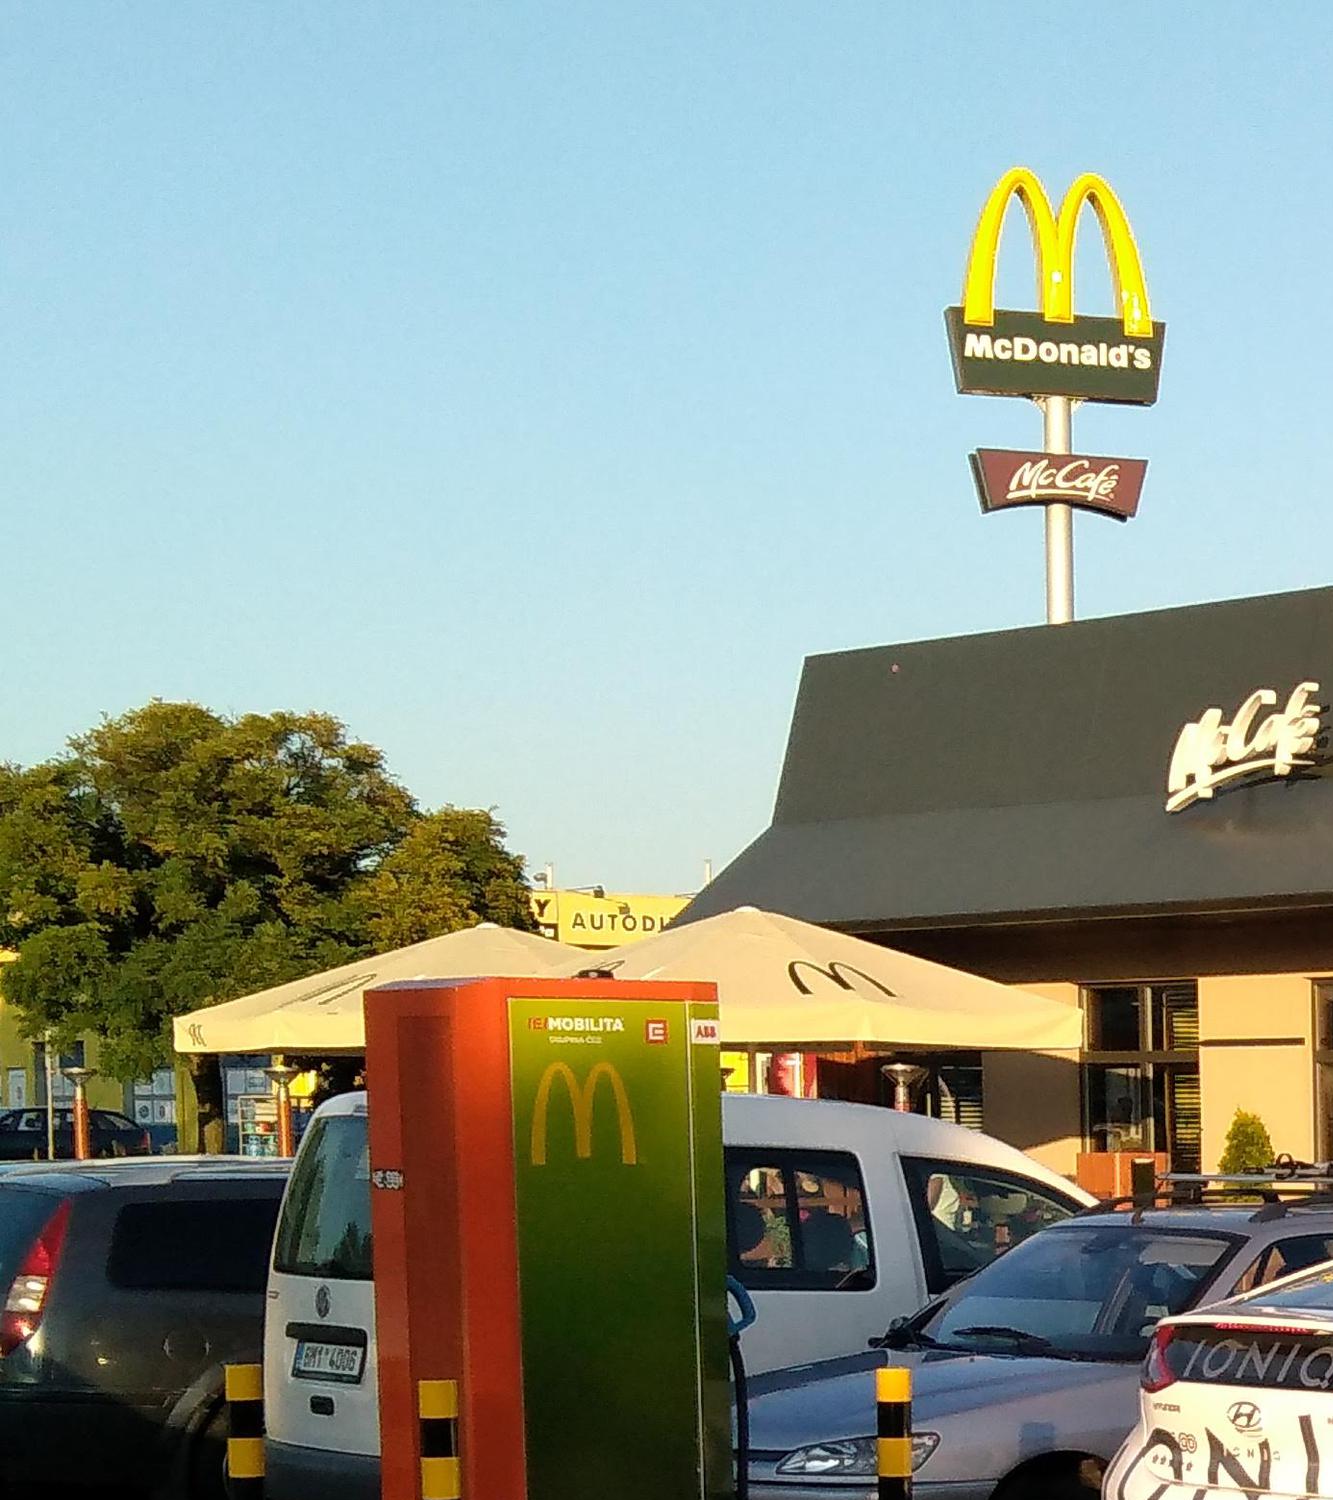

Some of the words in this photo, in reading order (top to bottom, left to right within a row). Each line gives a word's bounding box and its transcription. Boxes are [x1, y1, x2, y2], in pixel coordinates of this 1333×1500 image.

[963, 333, 1152, 369] McDonald's
[1006, 458, 1120, 500] McCafé
[695, 1024, 717, 1038] ABB
